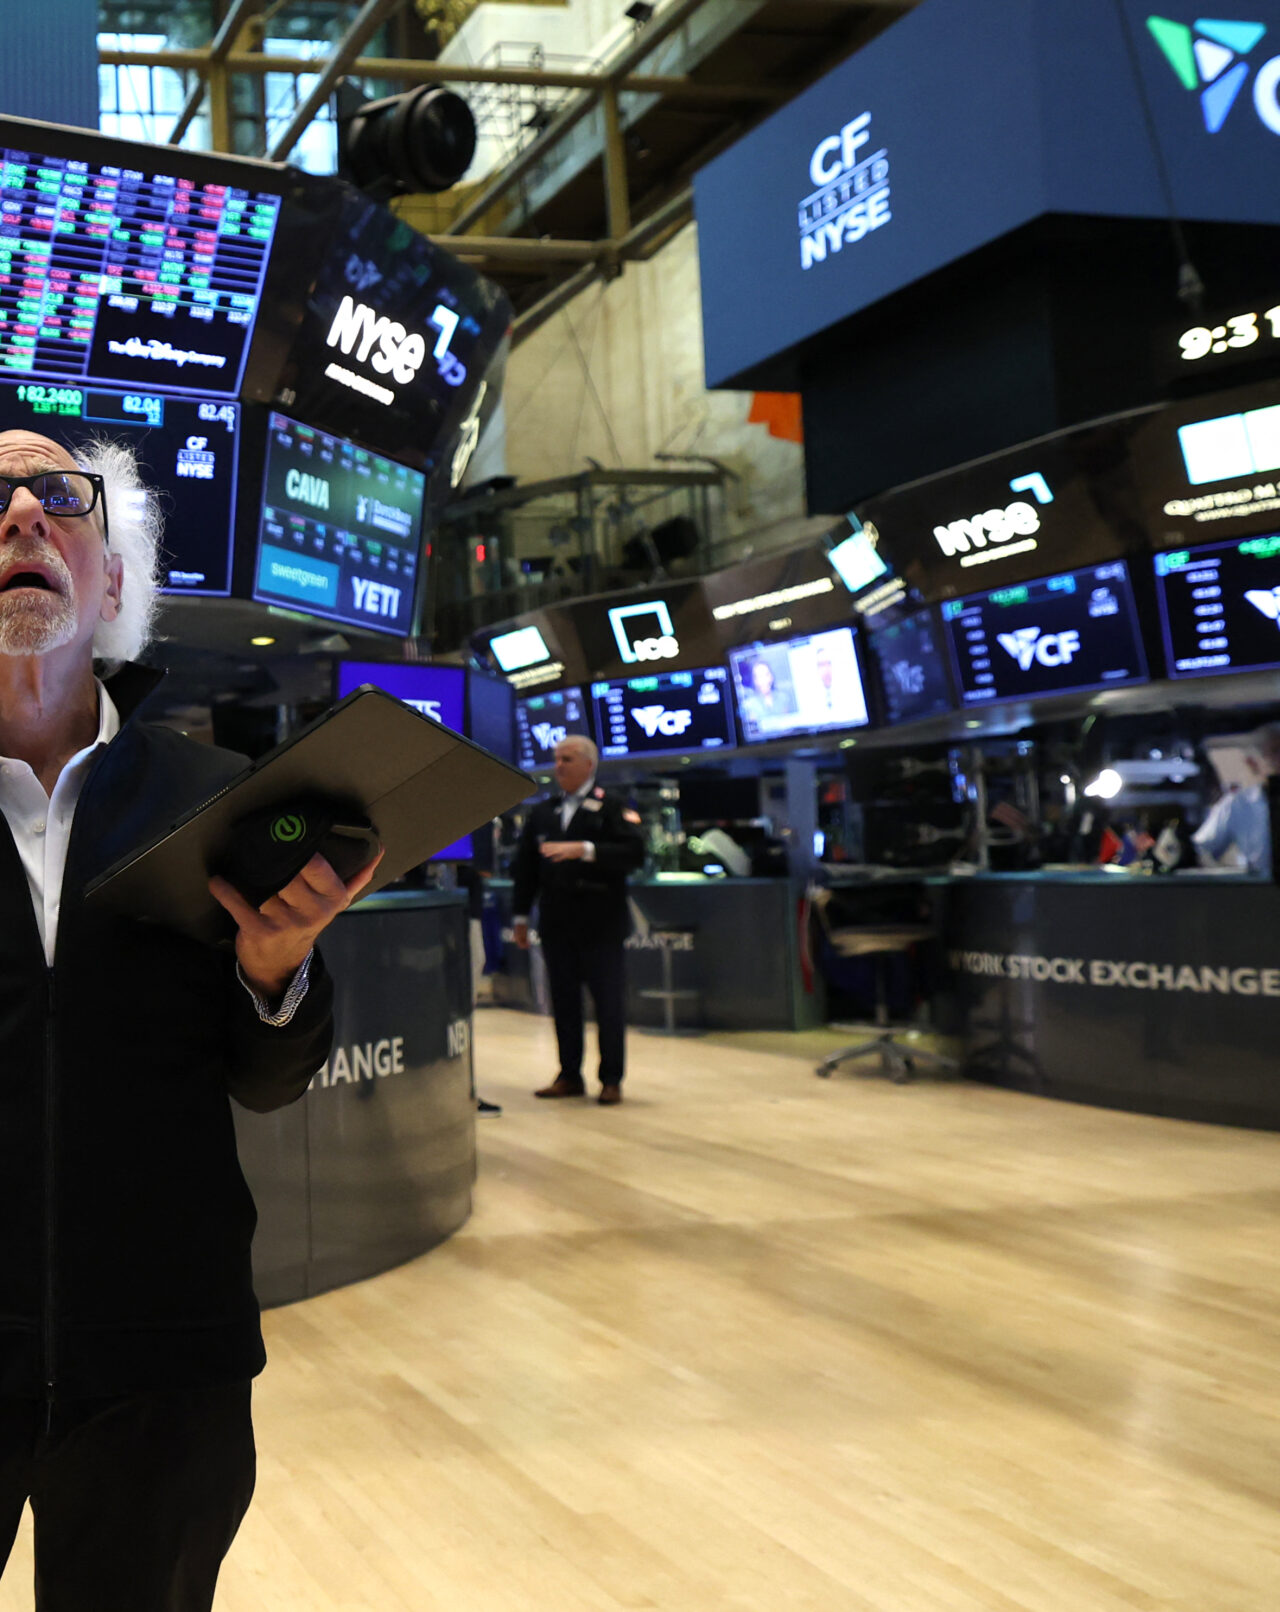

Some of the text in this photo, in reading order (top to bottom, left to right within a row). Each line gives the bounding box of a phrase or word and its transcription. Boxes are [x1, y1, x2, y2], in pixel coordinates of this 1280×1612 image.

[810, 111, 871, 187] CF
[799, 159, 889, 229] LISTED
[801, 187, 891, 270] NYSE
[123, 395, 160, 414] 82.04
[198, 404, 235, 421] 82.45
[186, 436, 208, 450] CF
[176, 463, 214, 479] NYSE
[285, 468, 330, 511] CAVA
[351, 576, 400, 618] YETI
[1035, 629, 1081, 668] CF
[658, 709, 691, 736] CF
[1006, 955, 1087, 984] STOCK
[1089, 959, 1280, 996] EXCHANGE
